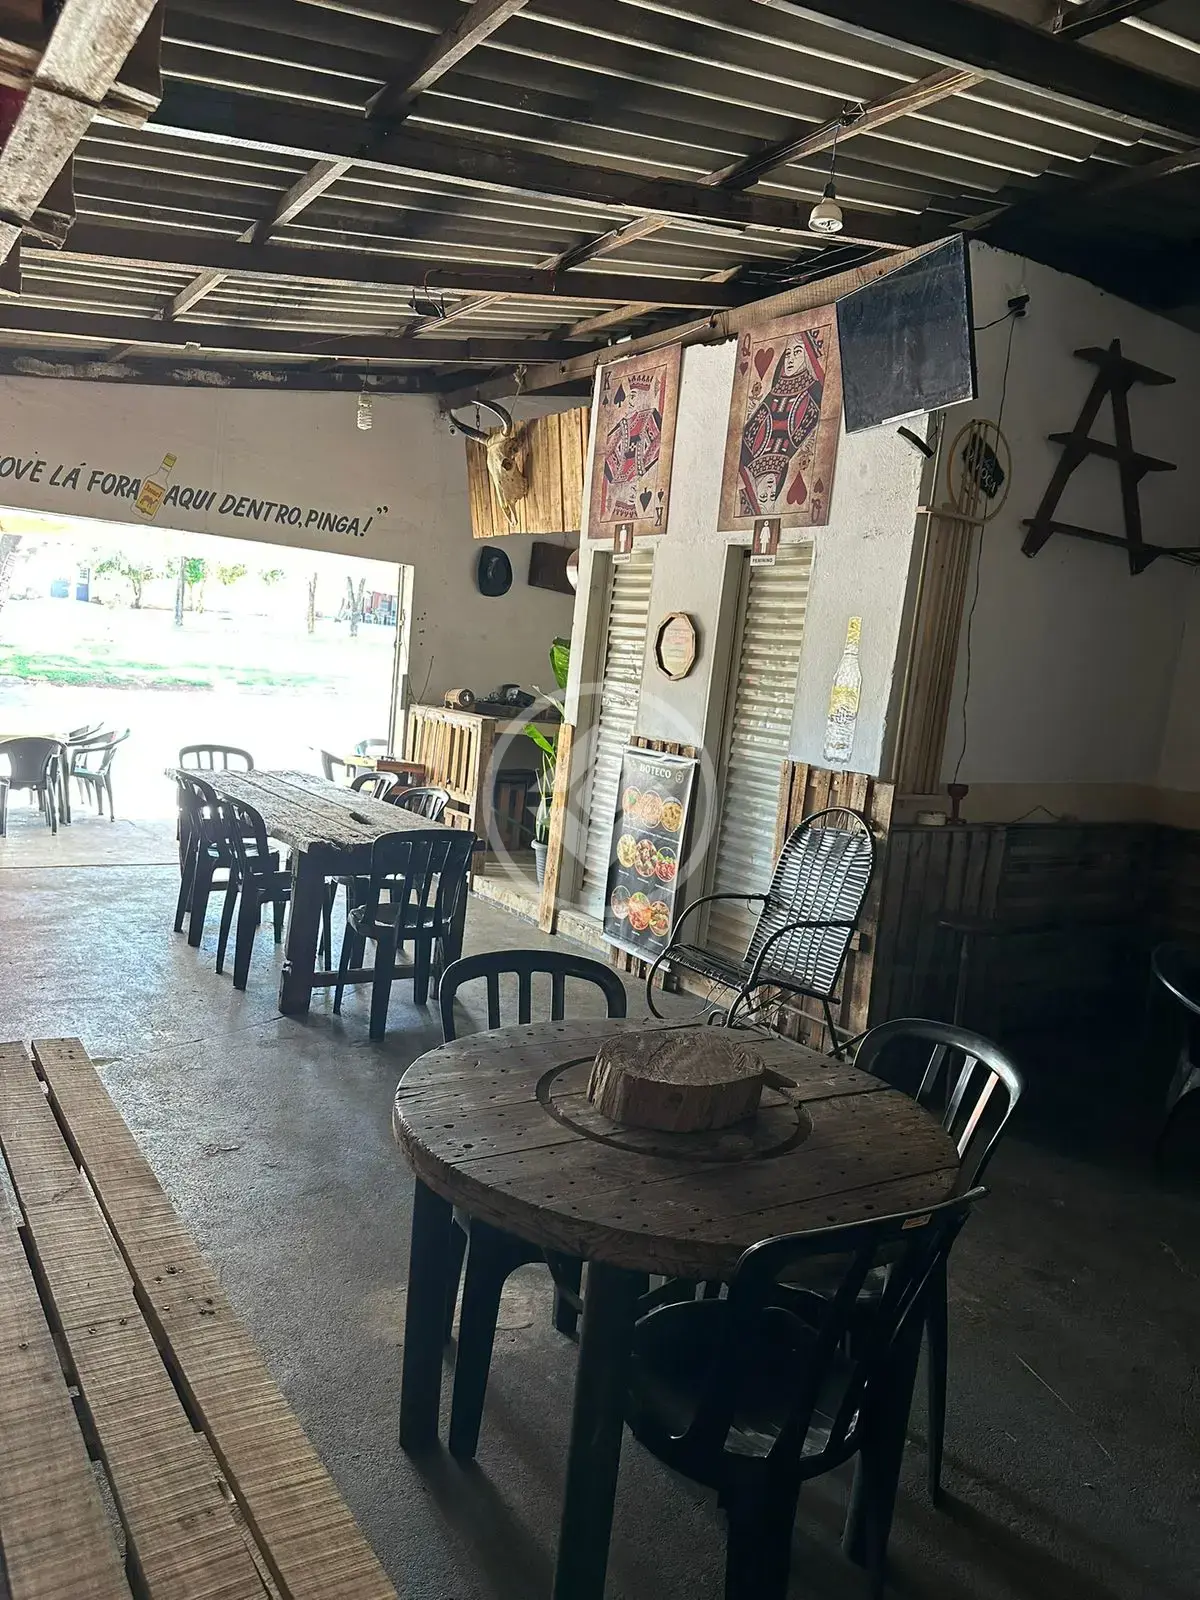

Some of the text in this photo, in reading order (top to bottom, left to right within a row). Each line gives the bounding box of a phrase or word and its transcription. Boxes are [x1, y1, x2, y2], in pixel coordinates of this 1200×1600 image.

[741, 333, 752, 357] Q
[603, 371, 612, 391] K
[0, 456, 47, 483] OVE
[49, 462, 86, 490] LÁ
[86, 470, 141, 500] FORA
[163, 485, 217, 511] AQUI
[218, 494, 302, 528] DENTRO,
[655, 506, 664, 526] K
[639, 763, 672, 779] BOTECO
